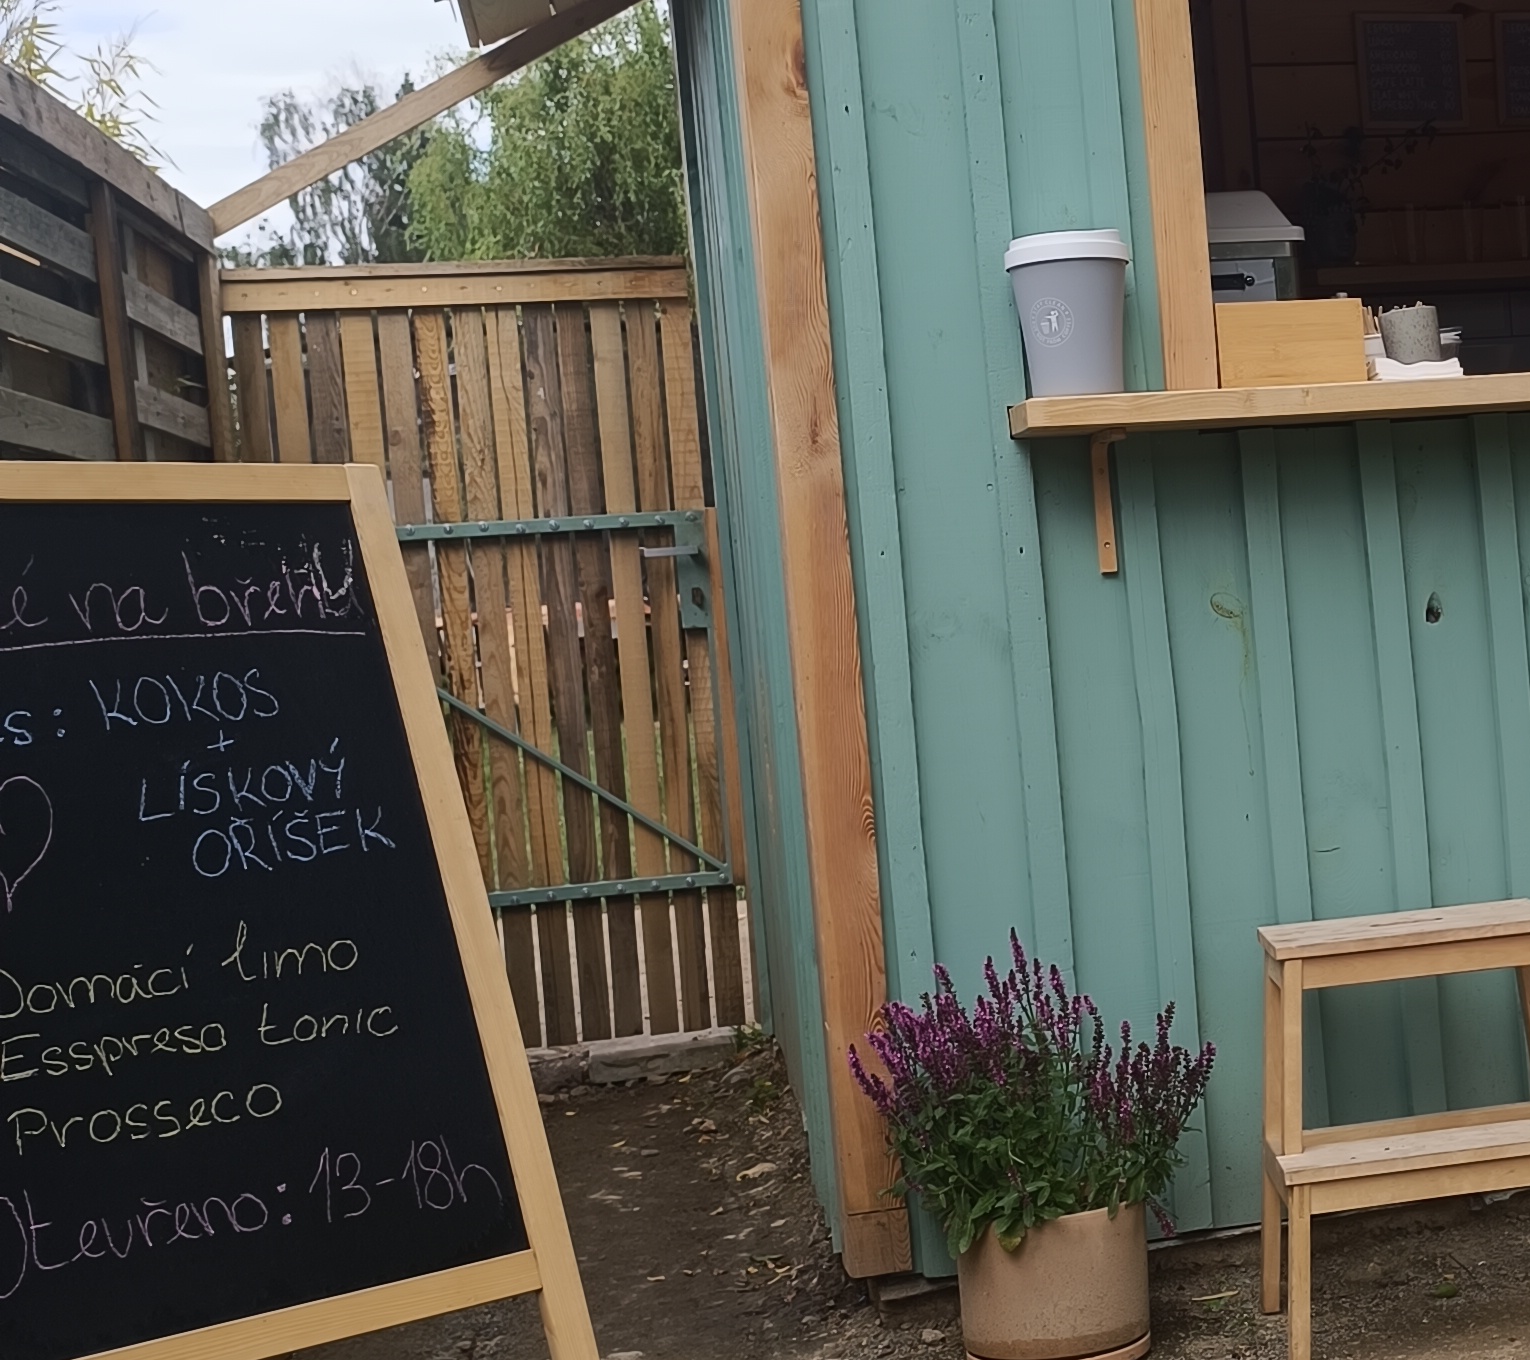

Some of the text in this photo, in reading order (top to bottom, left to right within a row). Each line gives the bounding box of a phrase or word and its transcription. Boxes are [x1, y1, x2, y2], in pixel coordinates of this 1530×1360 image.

[69, 583, 168, 631] na
[0, 668, 280, 747] S: KOKOS
[207, 729, 235, 753] +
[138, 736, 346, 822] LÍSKOVÝ
[192, 805, 397, 878] OŘÍŠEK
[257, 1002, 400, 1046] tonic
[7, 1083, 283, 1156] Prosseco
